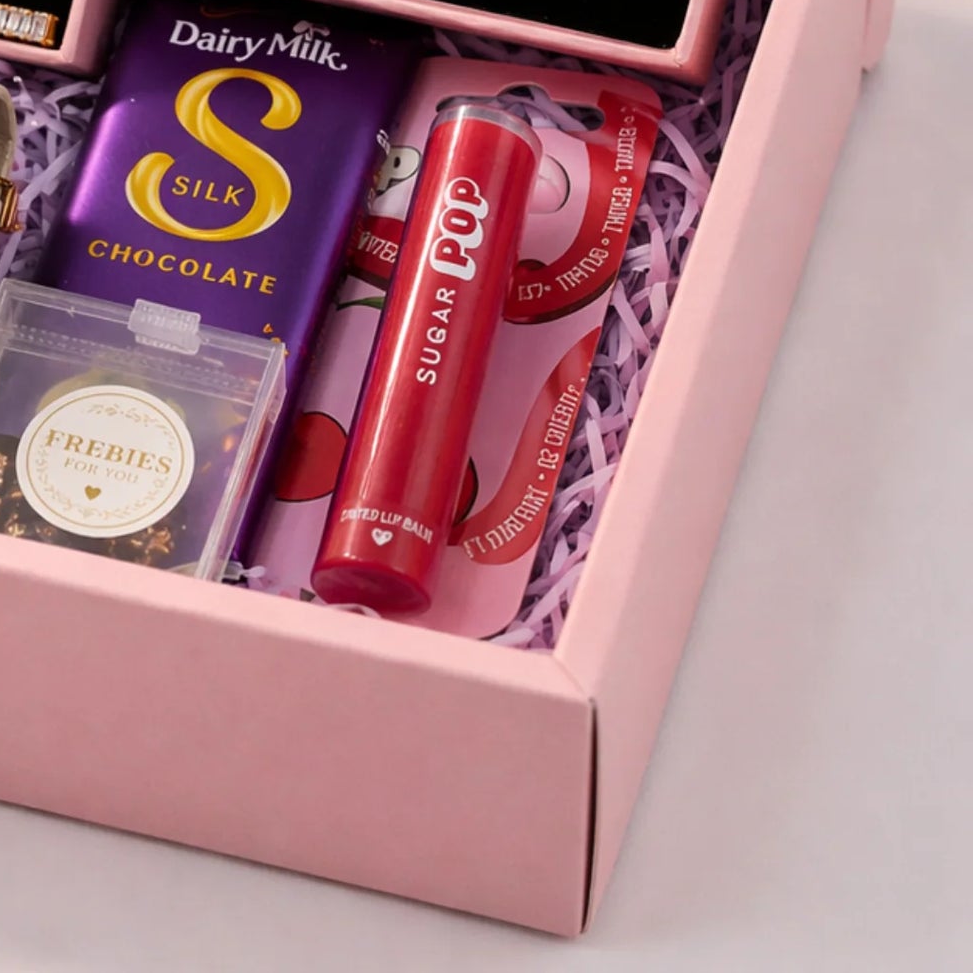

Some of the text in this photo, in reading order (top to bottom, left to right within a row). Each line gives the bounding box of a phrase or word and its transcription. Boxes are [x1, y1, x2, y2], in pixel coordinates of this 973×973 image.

[169, 19, 348, 71] Dairy Milk
[171, 176, 245, 207] SILK
[87, 239, 277, 295] CHOCOLATE
[416, 176, 489, 385] SUGAR POP
[45, 429, 173, 475] FREBIES
[64, 457, 140, 484] FOR YOU
